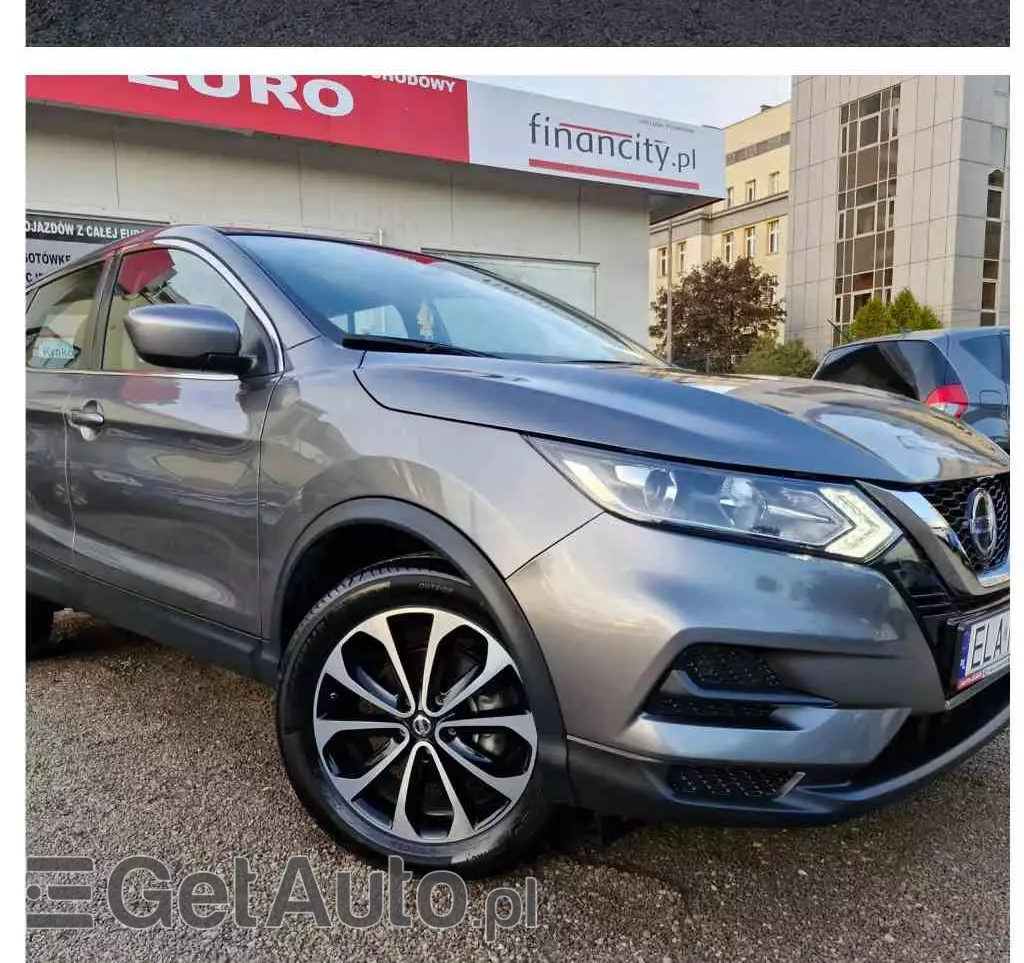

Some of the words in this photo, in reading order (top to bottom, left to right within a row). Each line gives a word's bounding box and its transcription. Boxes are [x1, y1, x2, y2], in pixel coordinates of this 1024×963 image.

[361, 75, 456, 93] HODOWY
[529, 113, 696, 173] financity.pl
[76, 225, 84, 237] Z
[86, 226, 117, 239] CAŁEJ
